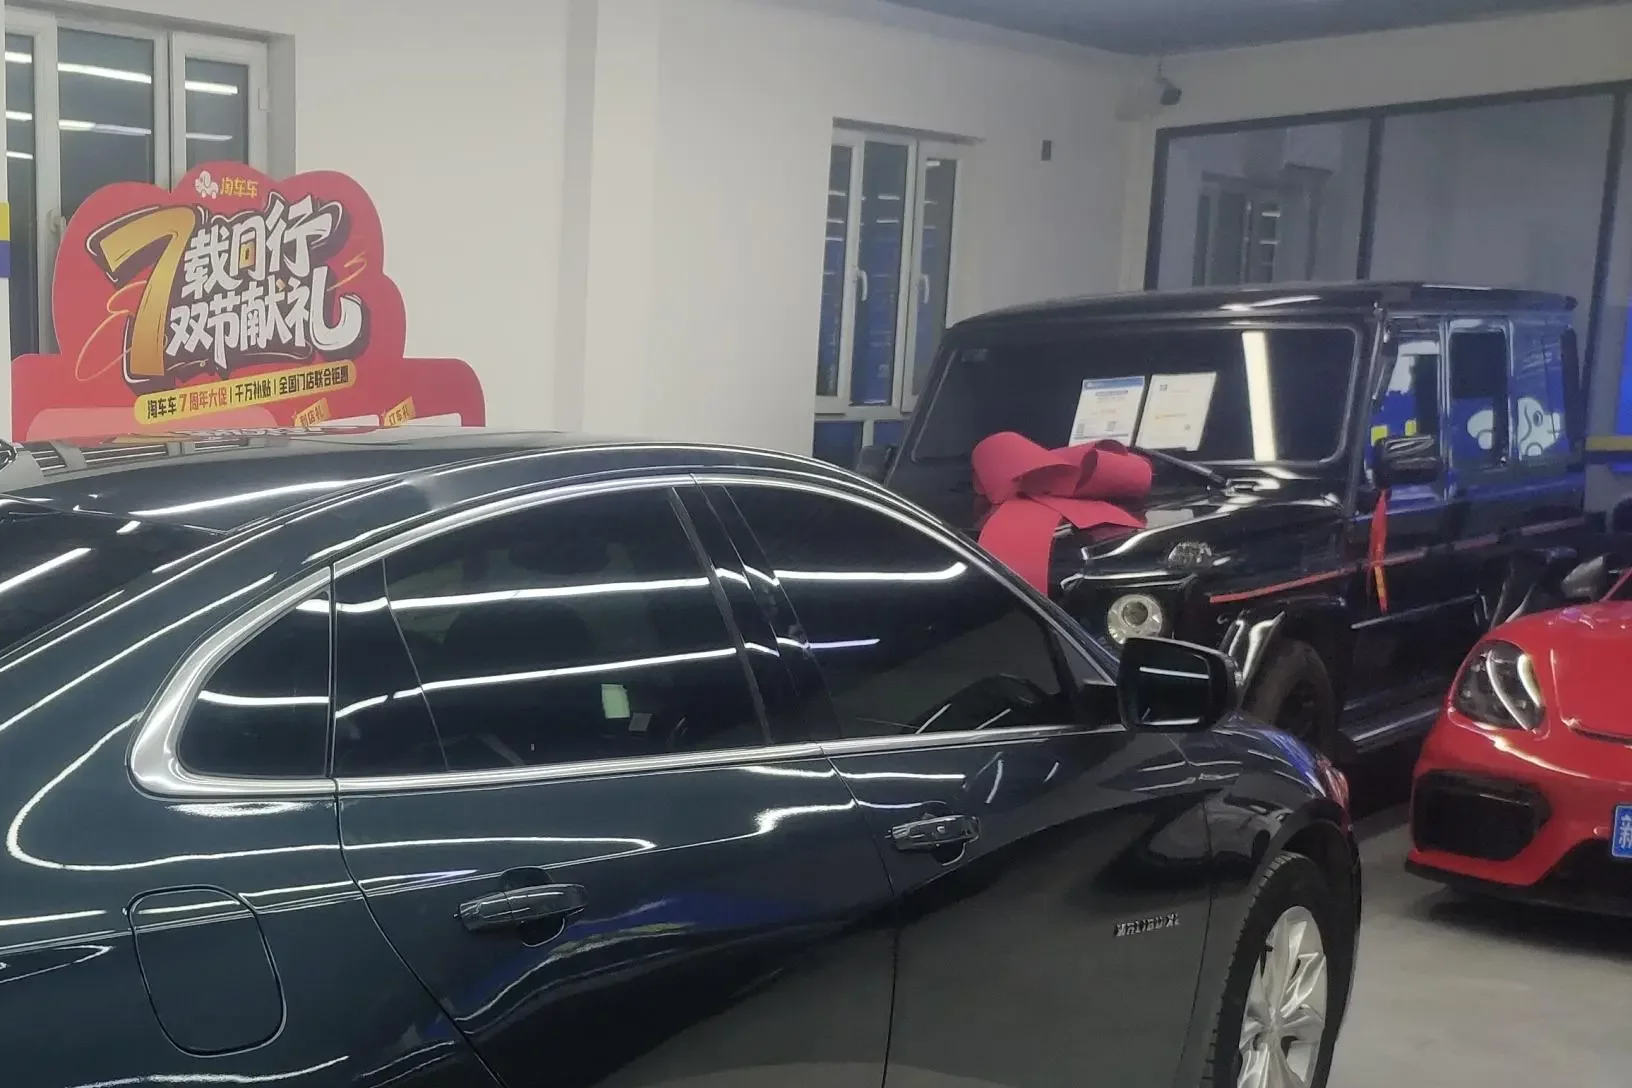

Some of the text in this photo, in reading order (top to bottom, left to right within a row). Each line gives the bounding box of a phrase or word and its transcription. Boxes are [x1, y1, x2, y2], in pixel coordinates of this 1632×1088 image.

[220, 176, 258, 198] 淘车车
[181, 195, 333, 299] 载同行
[165, 266, 362, 369] 双节献礼
